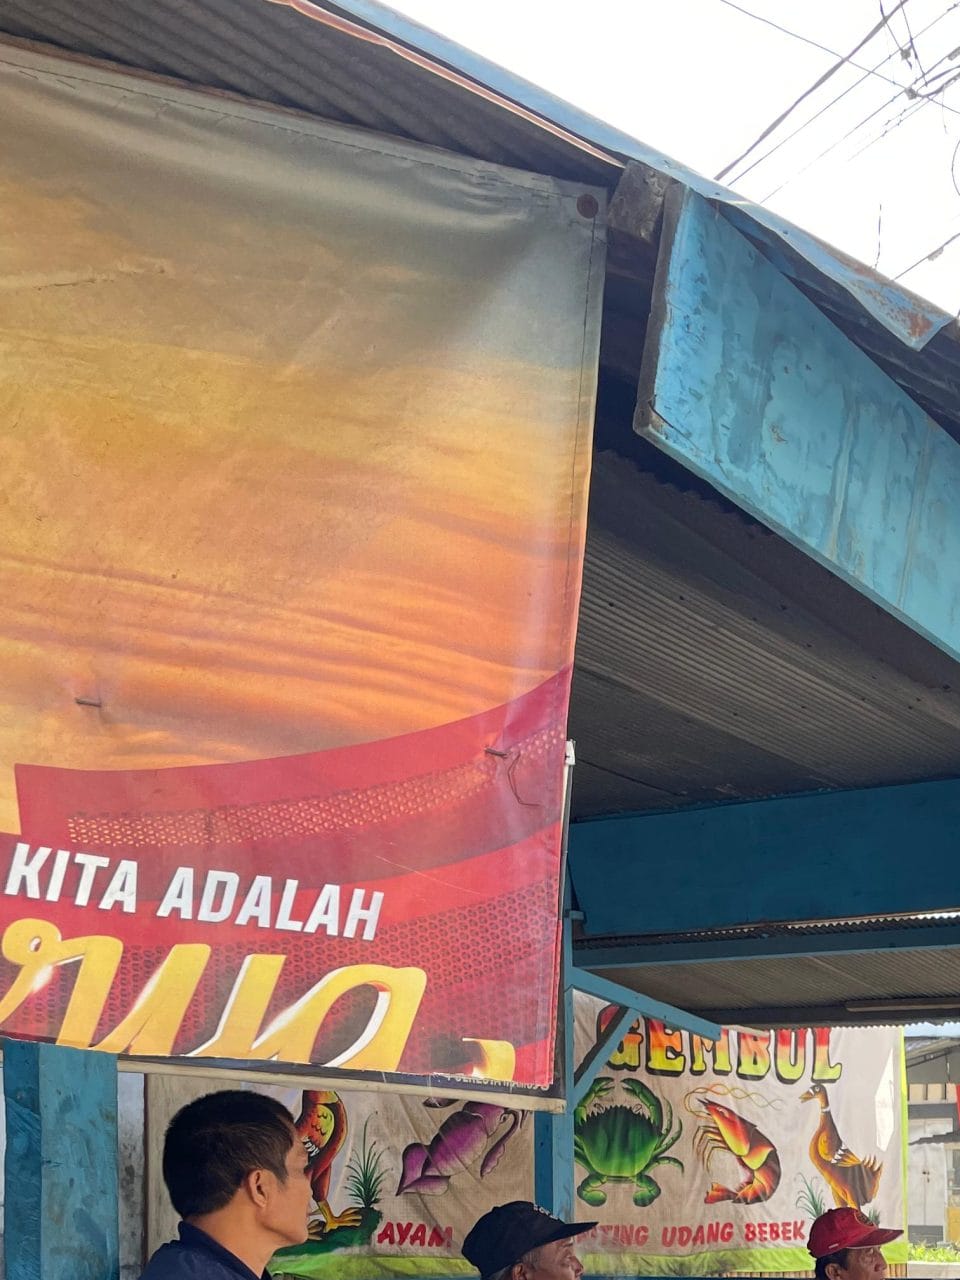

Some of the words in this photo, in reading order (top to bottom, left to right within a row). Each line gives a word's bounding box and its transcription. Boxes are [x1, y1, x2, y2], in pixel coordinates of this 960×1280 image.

[4, 842, 139, 914] KITA
[156, 865, 385, 941] ADALAH
[377, 1221, 453, 1248] AYAM
[661, 1221, 734, 1247] UDANG
[744, 1220, 805, 1243] BEBEK
